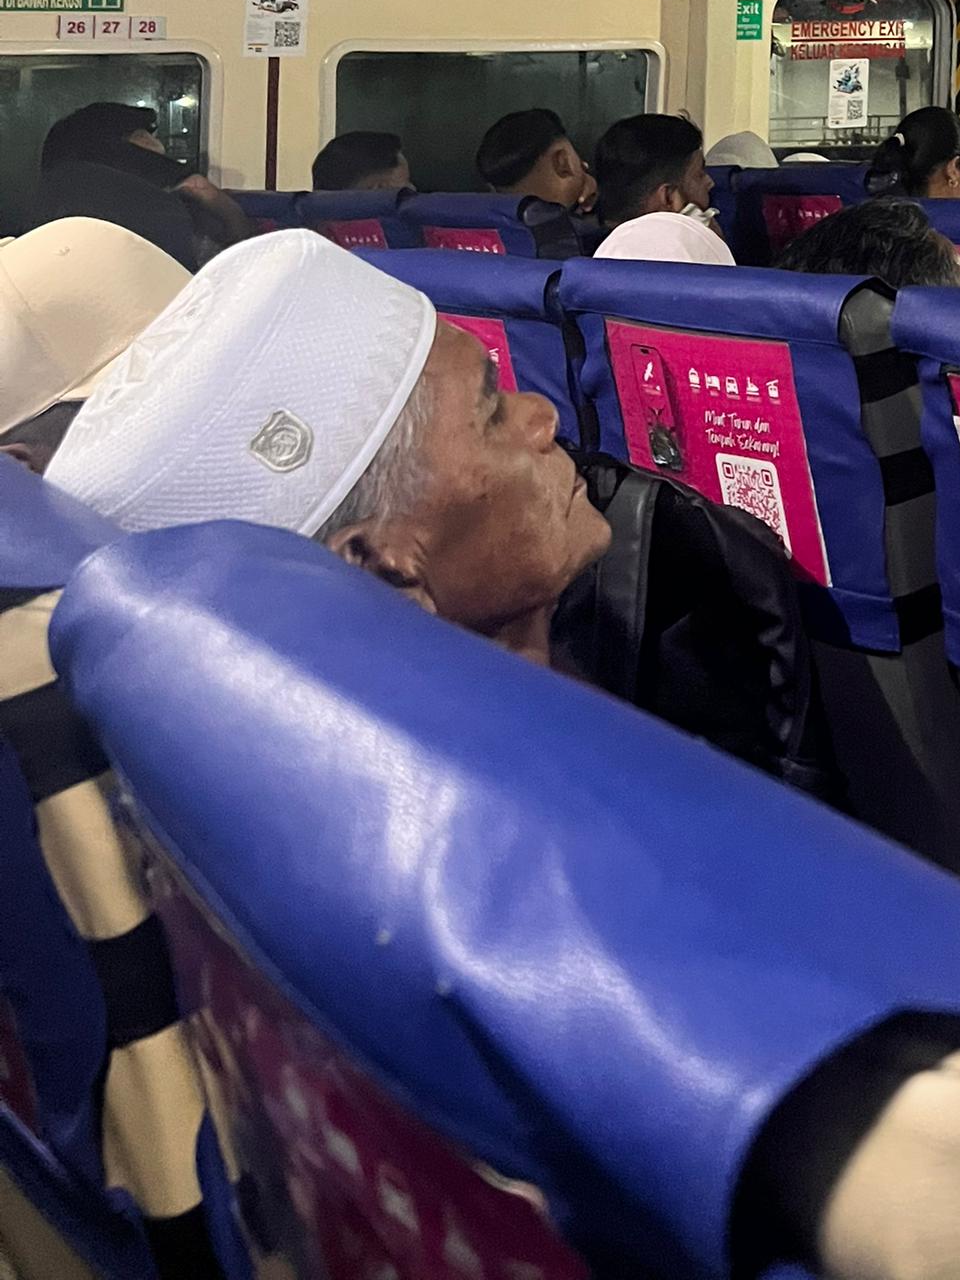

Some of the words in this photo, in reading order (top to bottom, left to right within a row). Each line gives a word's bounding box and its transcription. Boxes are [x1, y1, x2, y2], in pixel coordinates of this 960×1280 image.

[67, 21, 85, 34] 26
[102, 21, 120, 33] 27
[138, 21, 157, 34] 28
[791, 21, 876, 38] EMERGENCY
[791, 43, 835, 60] KELUAR
